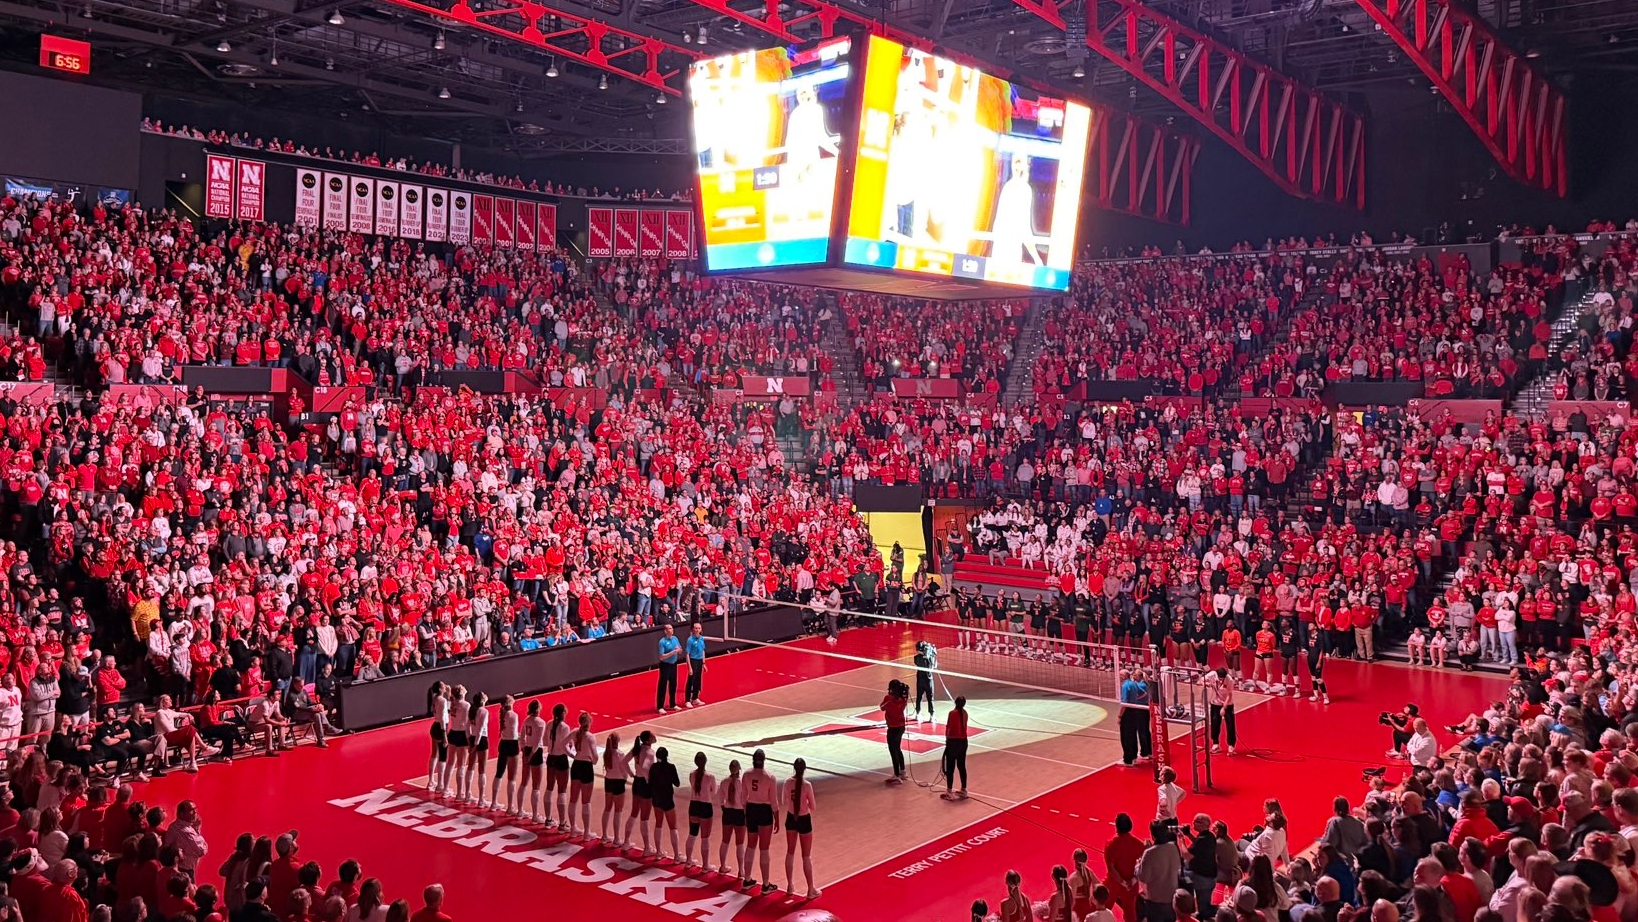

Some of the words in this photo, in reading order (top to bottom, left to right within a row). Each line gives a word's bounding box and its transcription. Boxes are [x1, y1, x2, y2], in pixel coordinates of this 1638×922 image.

[55, 54, 81, 69] 6:56
[212, 160, 230, 181] N
[242, 164, 260, 185] N
[211, 181, 230, 190] NCAA
[241, 185, 260, 194] NCAA
[302, 189, 315, 197] FINAL
[330, 194, 342, 202] FINAL
[356, 198, 368, 206] FINAL
[381, 201, 393, 209] FINAL
[210, 203, 230, 215] 2015
[240, 206, 259, 218] 2017
[455, 211, 466, 219] FINAL
[326, 220, 344, 228] 2005
[352, 221, 371, 229] 2008
[378, 225, 396, 233] 2016
[402, 227, 420, 235] 2018
[767, 378, 783, 393] N
[916, 380, 932, 394] N
[8, 694, 19, 707] N
[1154, 706, 1166, 781] NEBRASK
[751, 779, 759, 791] 5
[327, 787, 753, 922] NEBRASKA
[888, 859, 934, 879] TERRY
[927, 843, 972, 863] PETTIT
[966, 826, 1009, 846] COURT
